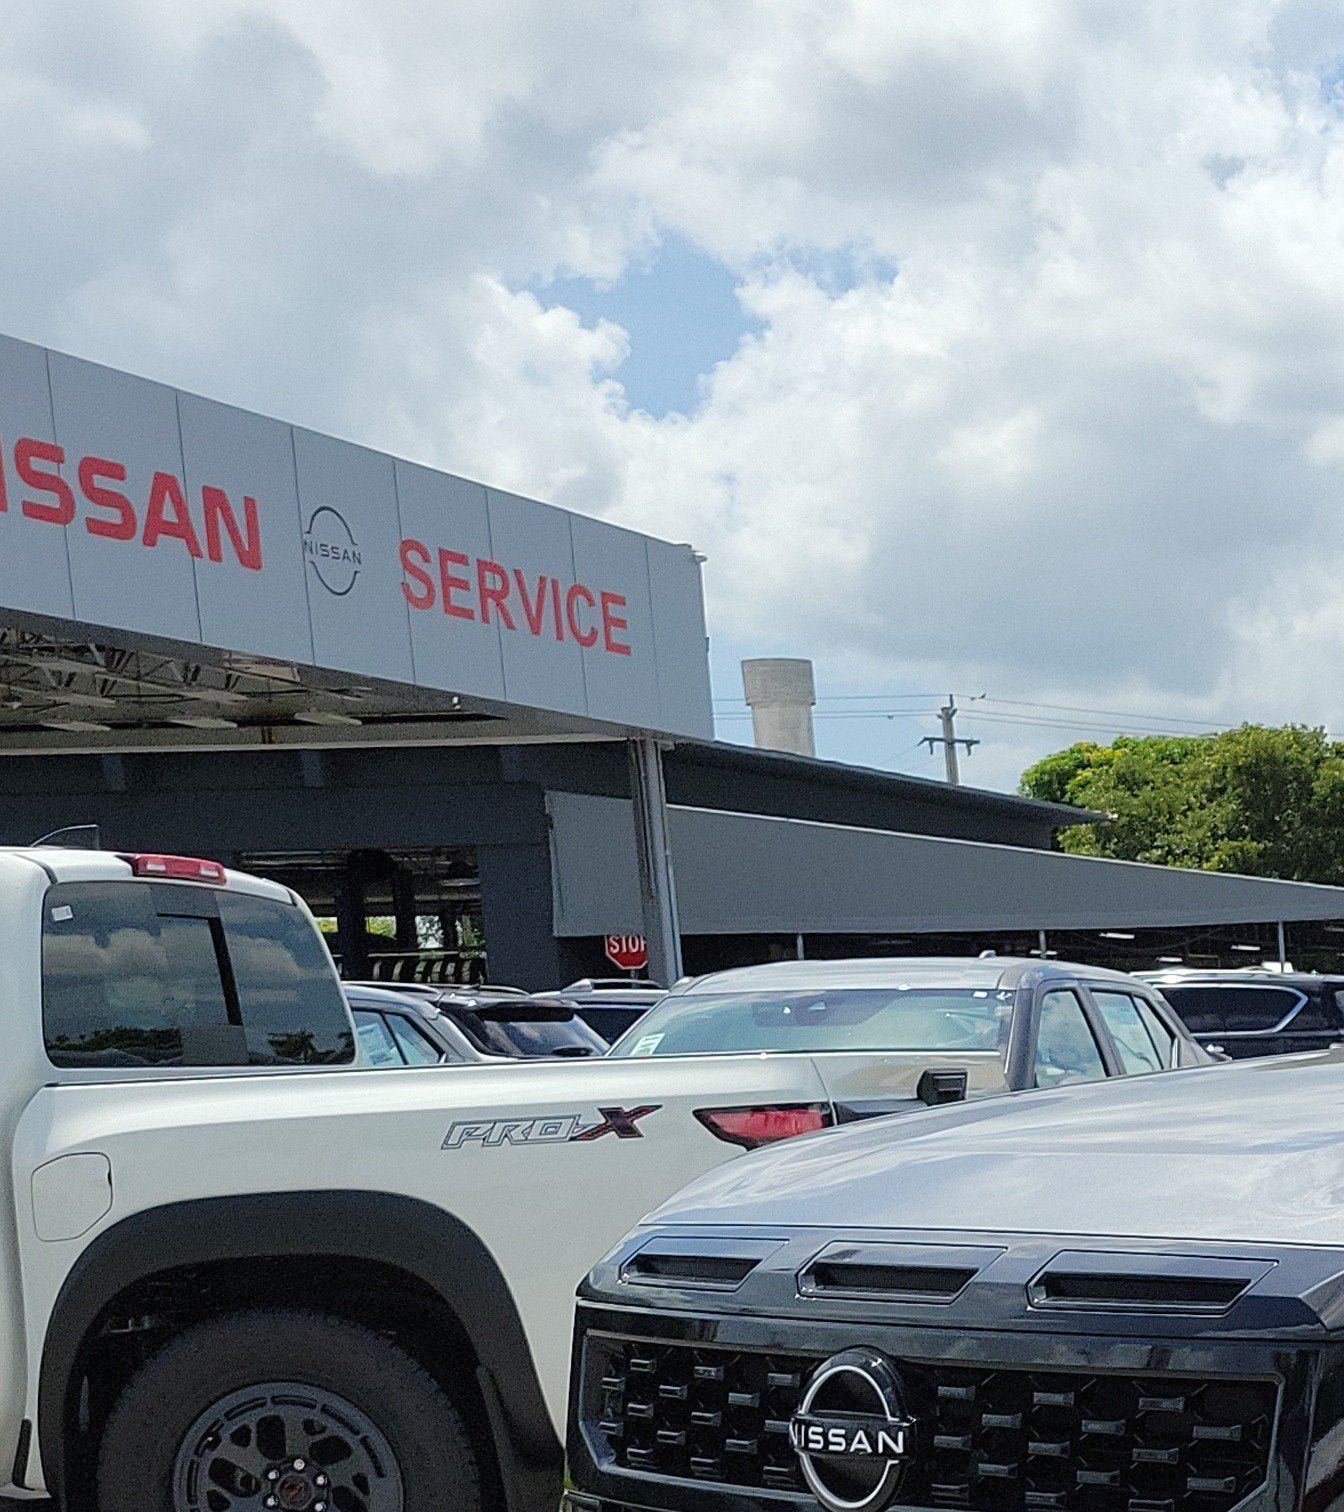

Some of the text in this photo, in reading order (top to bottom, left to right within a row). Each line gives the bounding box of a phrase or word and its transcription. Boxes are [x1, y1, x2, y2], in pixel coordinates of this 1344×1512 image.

[302, 539, 362, 565] NISSAN
[399, 538, 632, 656] SERVICE
[789, 1417, 904, 1454] NISSAN
